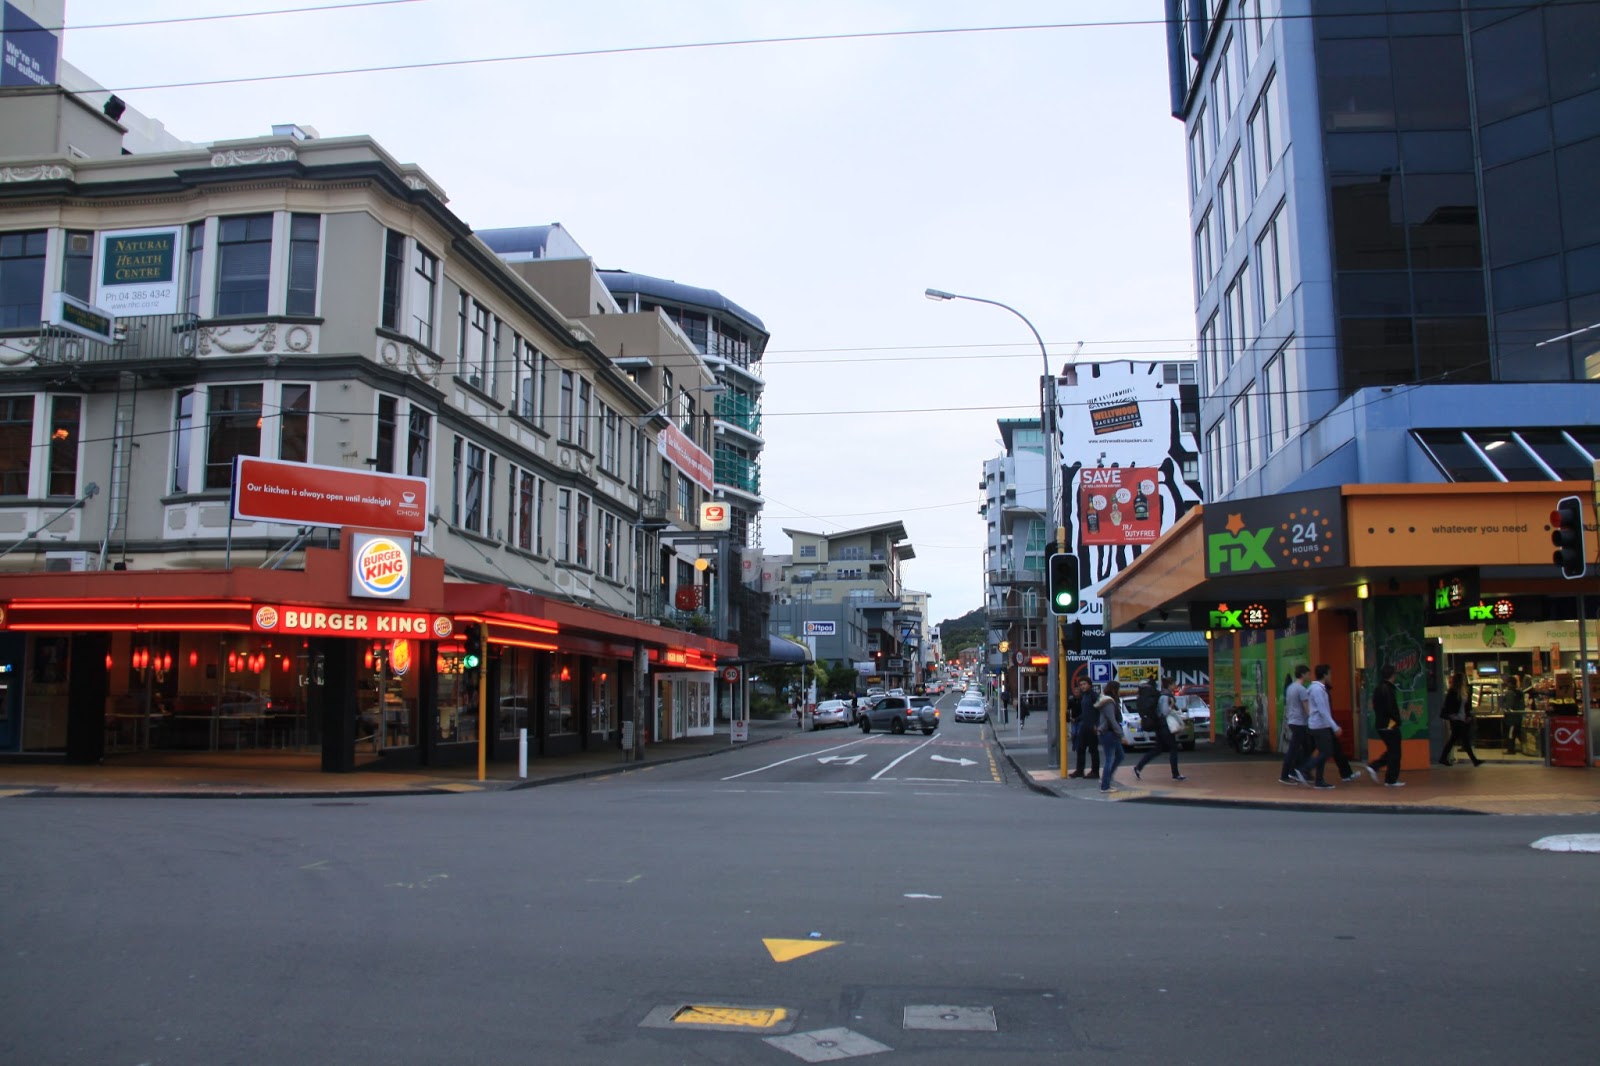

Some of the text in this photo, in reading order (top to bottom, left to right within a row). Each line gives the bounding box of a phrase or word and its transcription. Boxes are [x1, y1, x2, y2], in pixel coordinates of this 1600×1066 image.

[5, 54, 16, 68] all
[6, 40, 40, 71] We're in
[114, 240, 169, 252] NATURAL
[116, 254, 162, 266] HEALTH
[115, 268, 160, 280] CENTRE
[131, 291, 147, 300] 385
[150, 289, 171, 299] 4342
[1092, 405, 1138, 420] WELLYWOOD
[1082, 470, 1122, 484] SAVE
[247, 483, 392, 507] Our kitchen is always open until midnight
[396, 509, 420, 517] CHOW
[1291, 522, 1318, 544] 24
[1432, 524, 1528, 535] whatever you need
[1292, 545, 1319, 554] HOURS
[363, 550, 401, 566] BURGER
[365, 559, 403, 581] KING
[1249, 609, 1262, 618] 24
[1498, 604, 1508, 612] 24
[285, 611, 427, 634] BURGER KING
[1094, 665, 1108, 680] P
